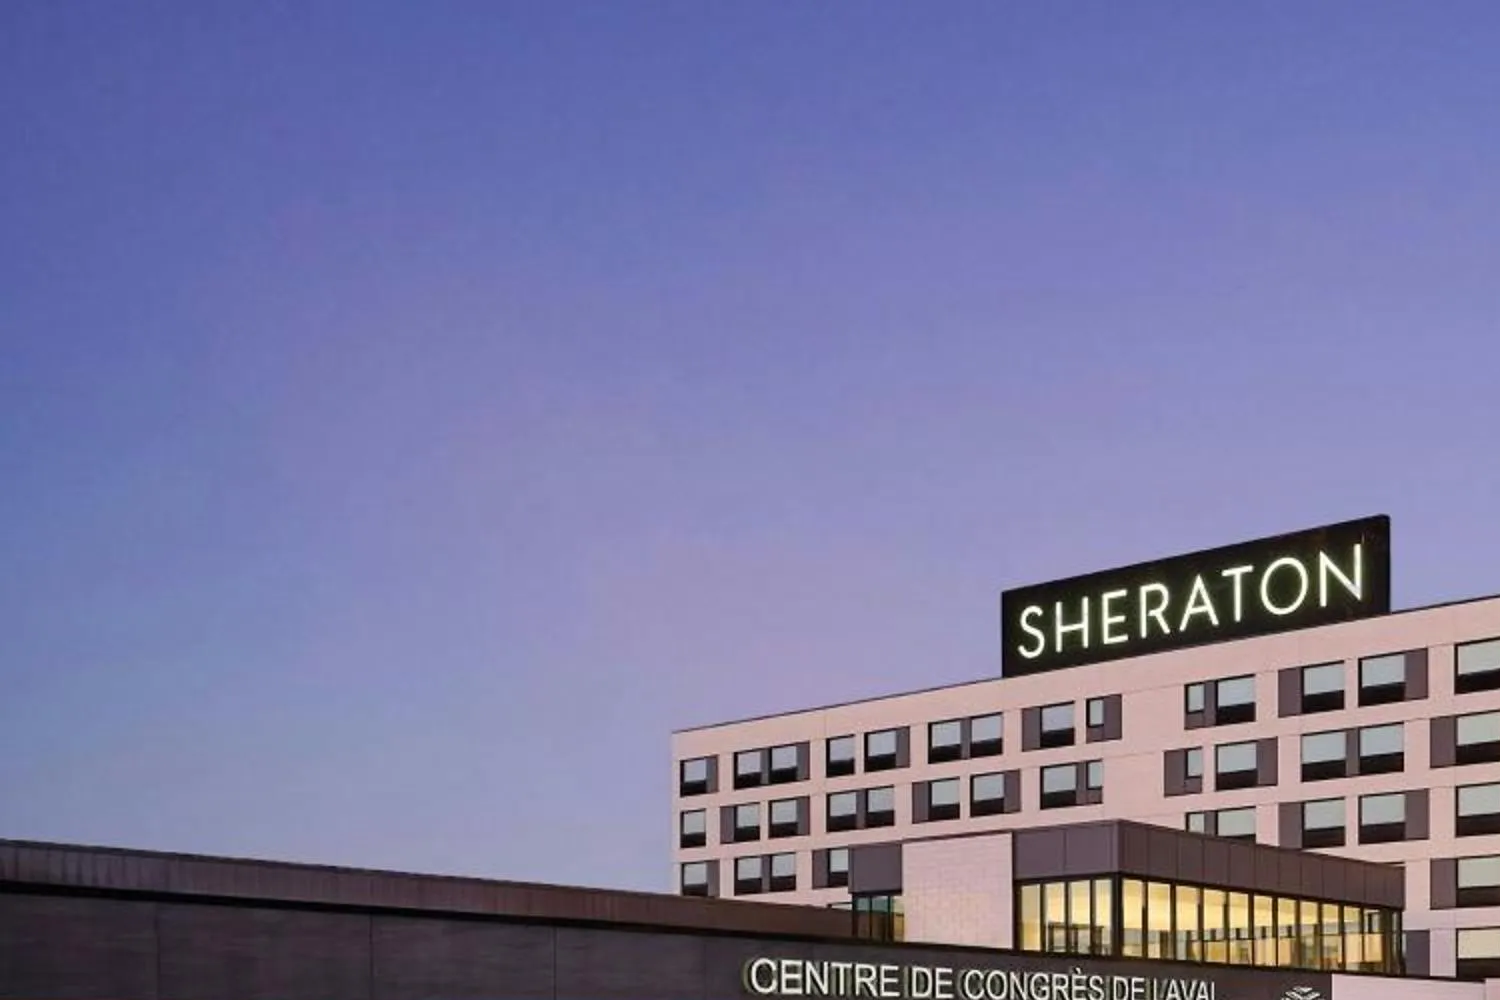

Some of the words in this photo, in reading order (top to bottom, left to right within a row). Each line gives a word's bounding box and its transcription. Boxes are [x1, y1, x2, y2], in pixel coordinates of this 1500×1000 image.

[1018, 543, 1362, 659] SHERATON
[750, 957, 898, 997] CENTRE
[912, 966, 953, 999] DE
